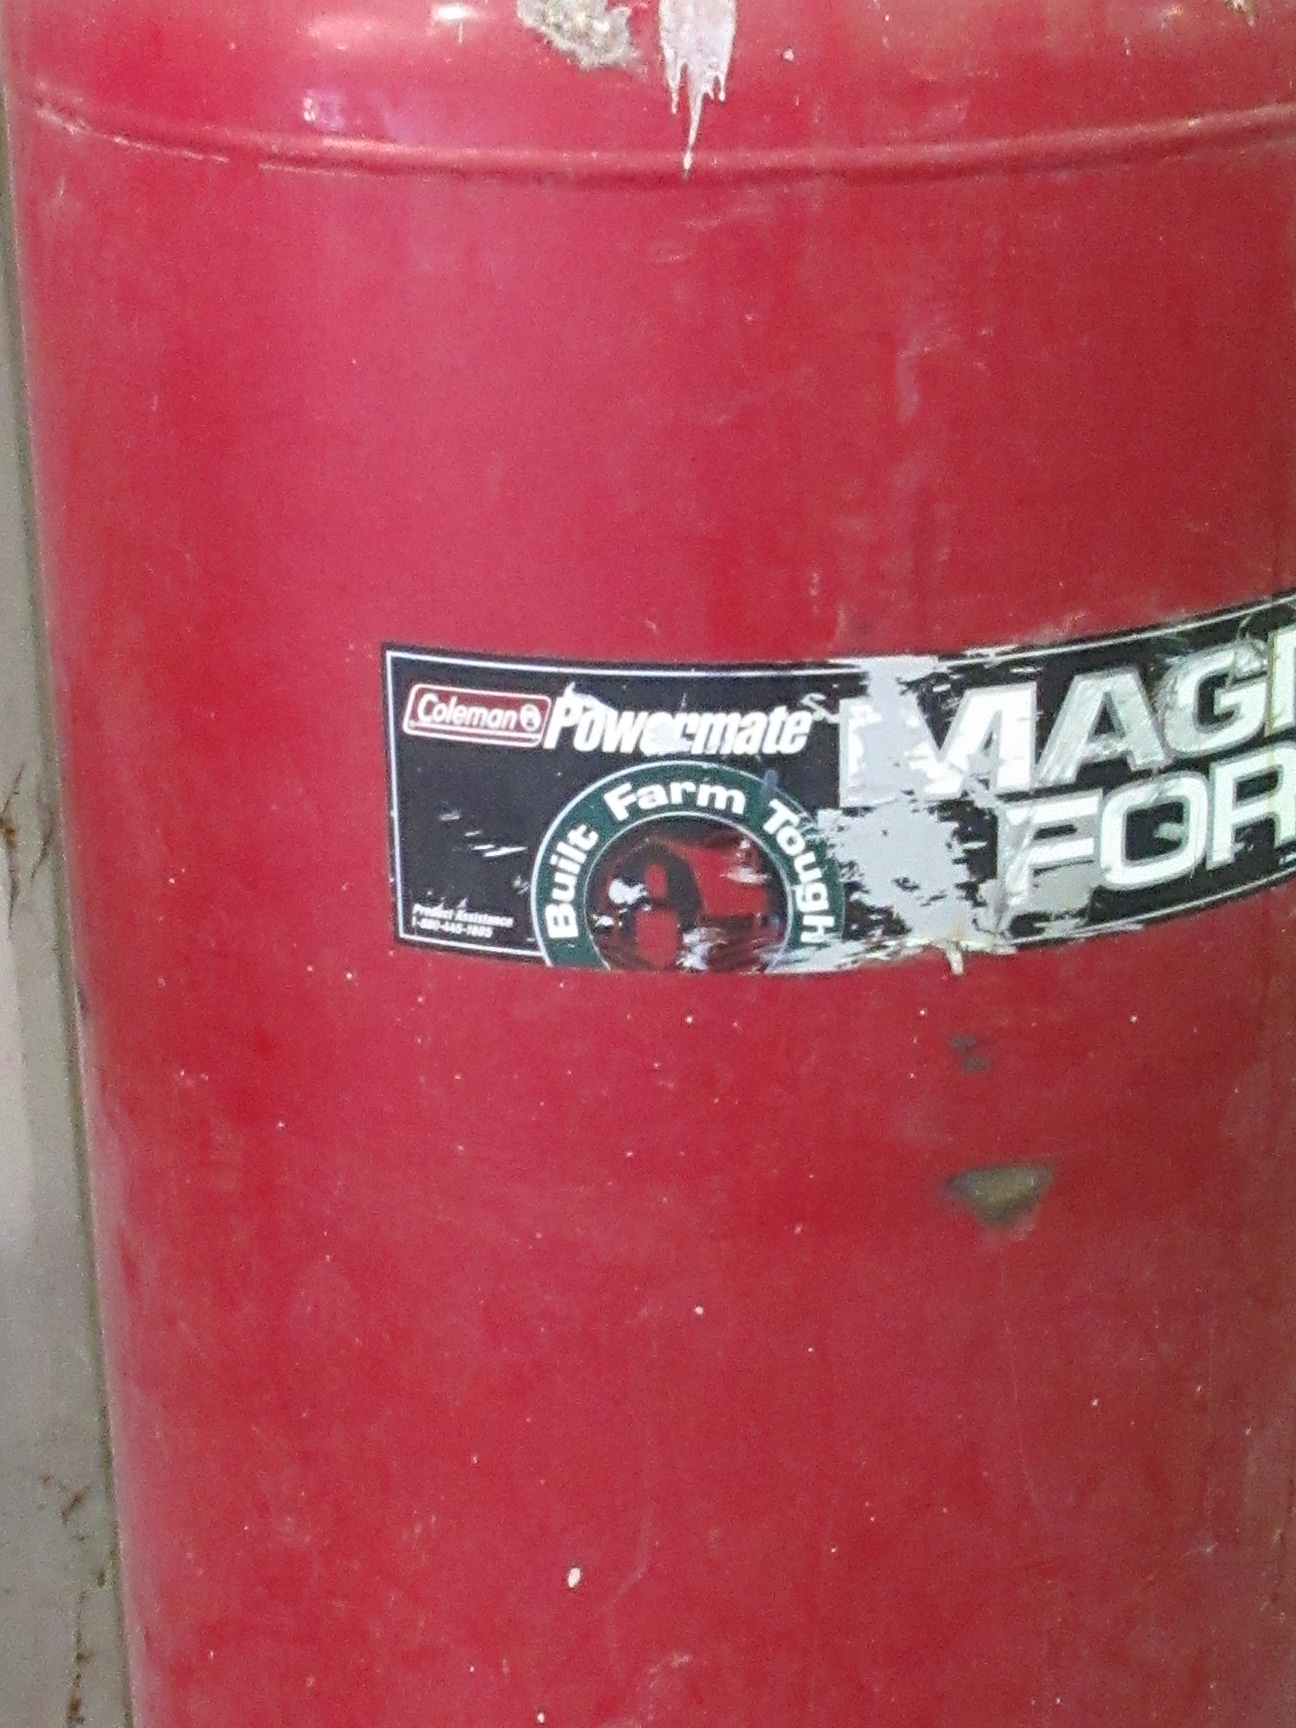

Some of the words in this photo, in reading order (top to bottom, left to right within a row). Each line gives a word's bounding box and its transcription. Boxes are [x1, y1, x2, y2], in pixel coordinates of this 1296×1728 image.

[416, 693, 520, 732] Coleman
[541, 692, 814, 756] Powermate
[544, 823, 600, 940] Built
[604, 780, 747, 822] Farm
[761, 798, 837, 945] Tough
[412, 903, 455, 920] Product
[454, 908, 515, 928] Assistance
